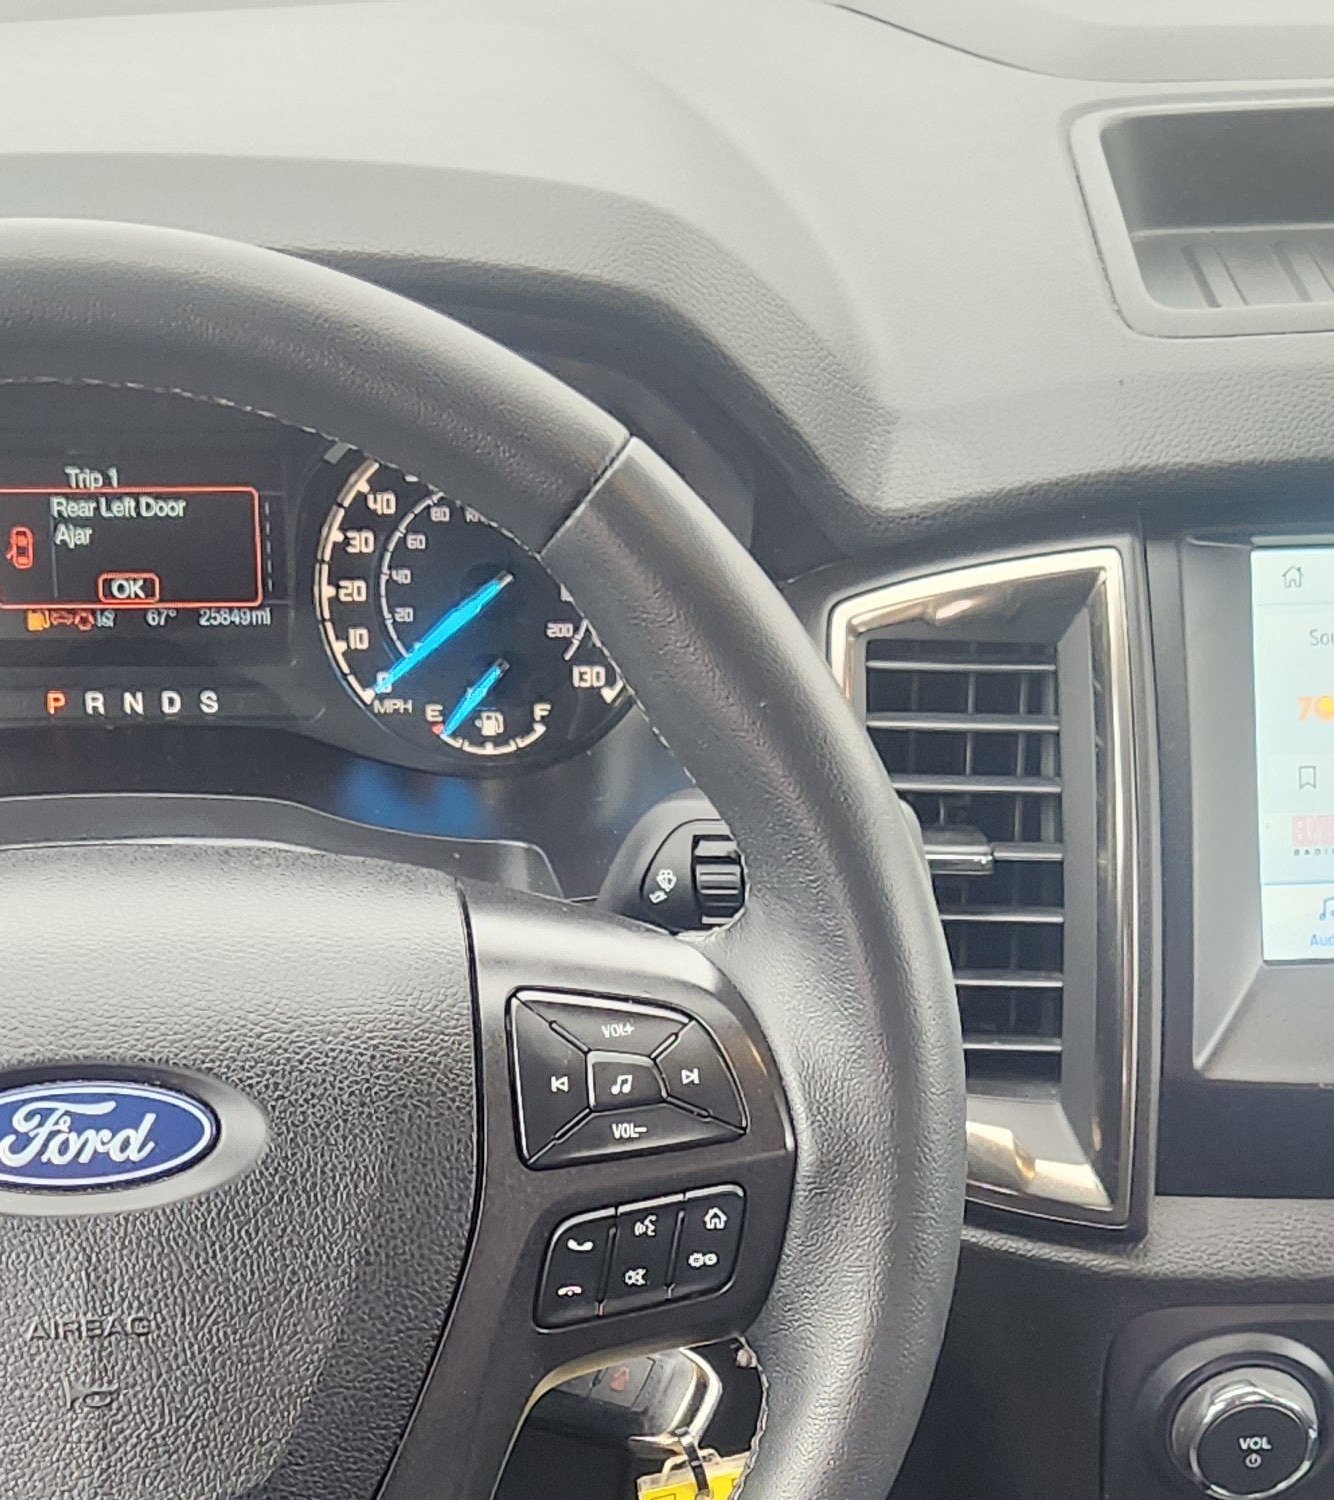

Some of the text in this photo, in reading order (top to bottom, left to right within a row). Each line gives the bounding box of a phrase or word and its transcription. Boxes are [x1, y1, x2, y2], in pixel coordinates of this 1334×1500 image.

[65, 466, 118, 490] Trip 1
[51, 496, 186, 517] Rear Left Door
[367, 492, 396, 515] 40
[54, 525, 93, 549] Ajar
[346, 530, 375, 553] 30
[110, 579, 145, 598] OK
[338, 580, 367, 602] 20
[348, 628, 370, 651] 10
[572, 664, 607, 688] 130
[47, 689, 219, 715] P R N D S
[372, 699, 413, 715] MPH
[425, 703, 444, 722] E
[533, 703, 552, 721] F
[29, 1313, 152, 1342] AIRBAG
[1238, 1435, 1273, 1451] VOL
